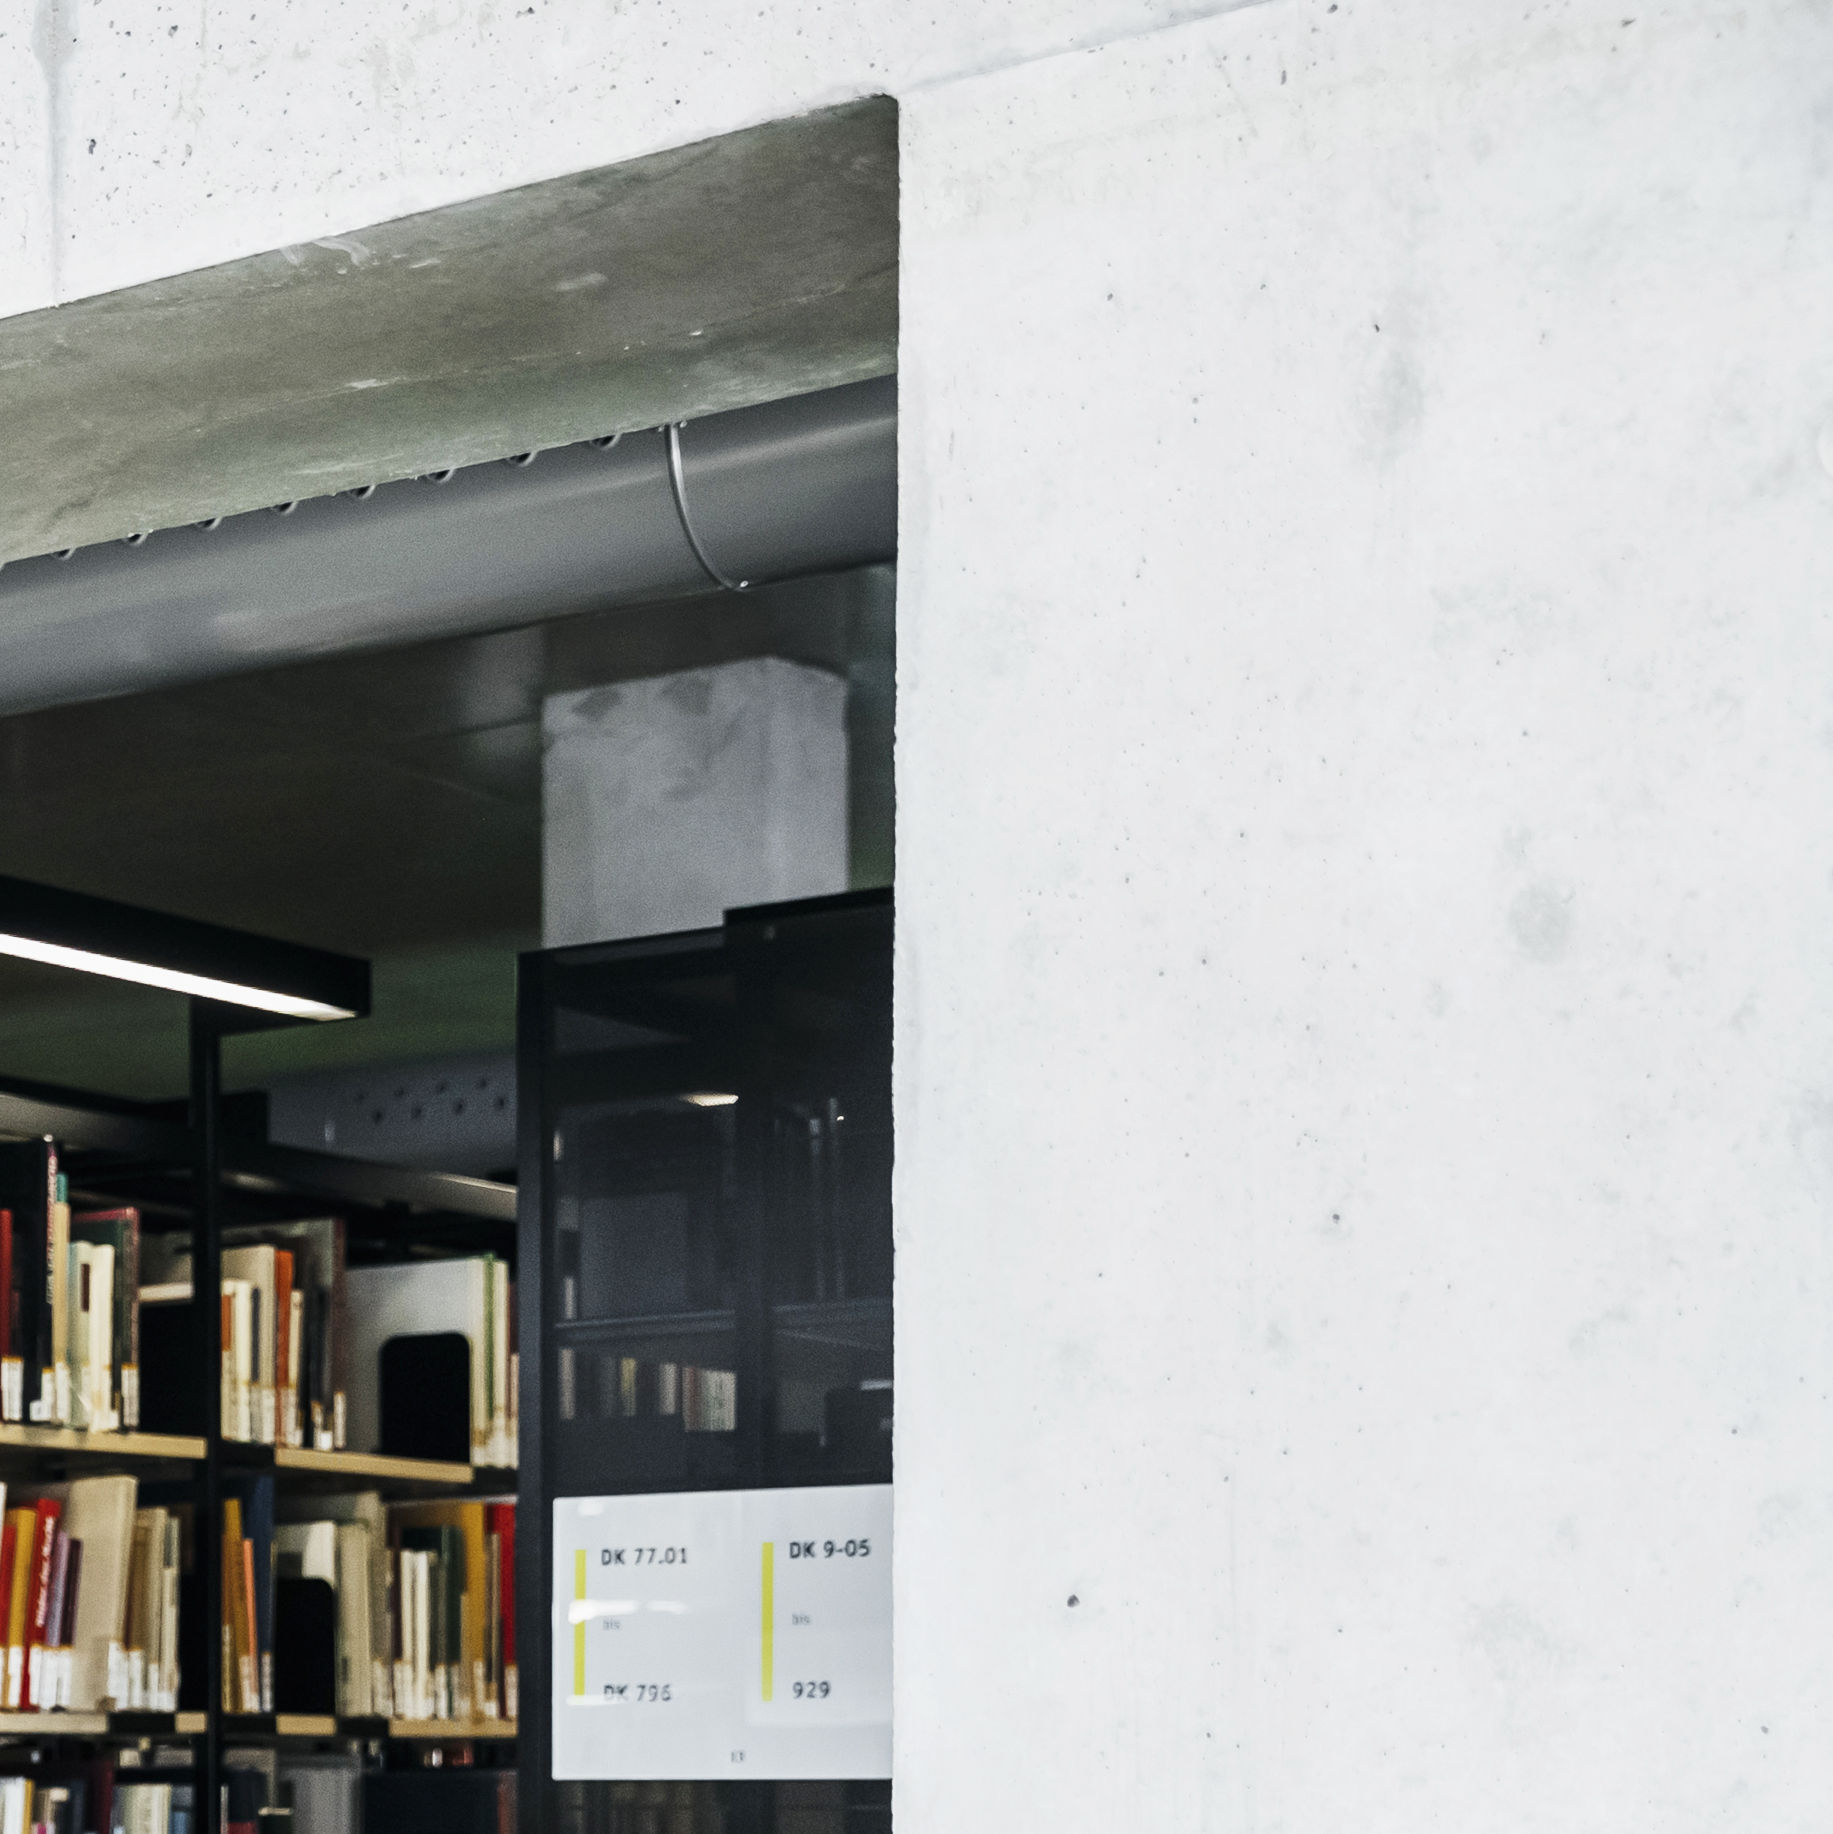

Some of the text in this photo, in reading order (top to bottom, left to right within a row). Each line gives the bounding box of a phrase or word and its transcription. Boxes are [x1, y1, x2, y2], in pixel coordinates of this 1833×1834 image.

[601, 1546, 688, 1565] DK 77.01
[788, 1538, 871, 1558] DK 9-05
[791, 1614, 810, 1625] bis
[604, 1683, 673, 1701] DK 796
[792, 1681, 831, 1698] 929
